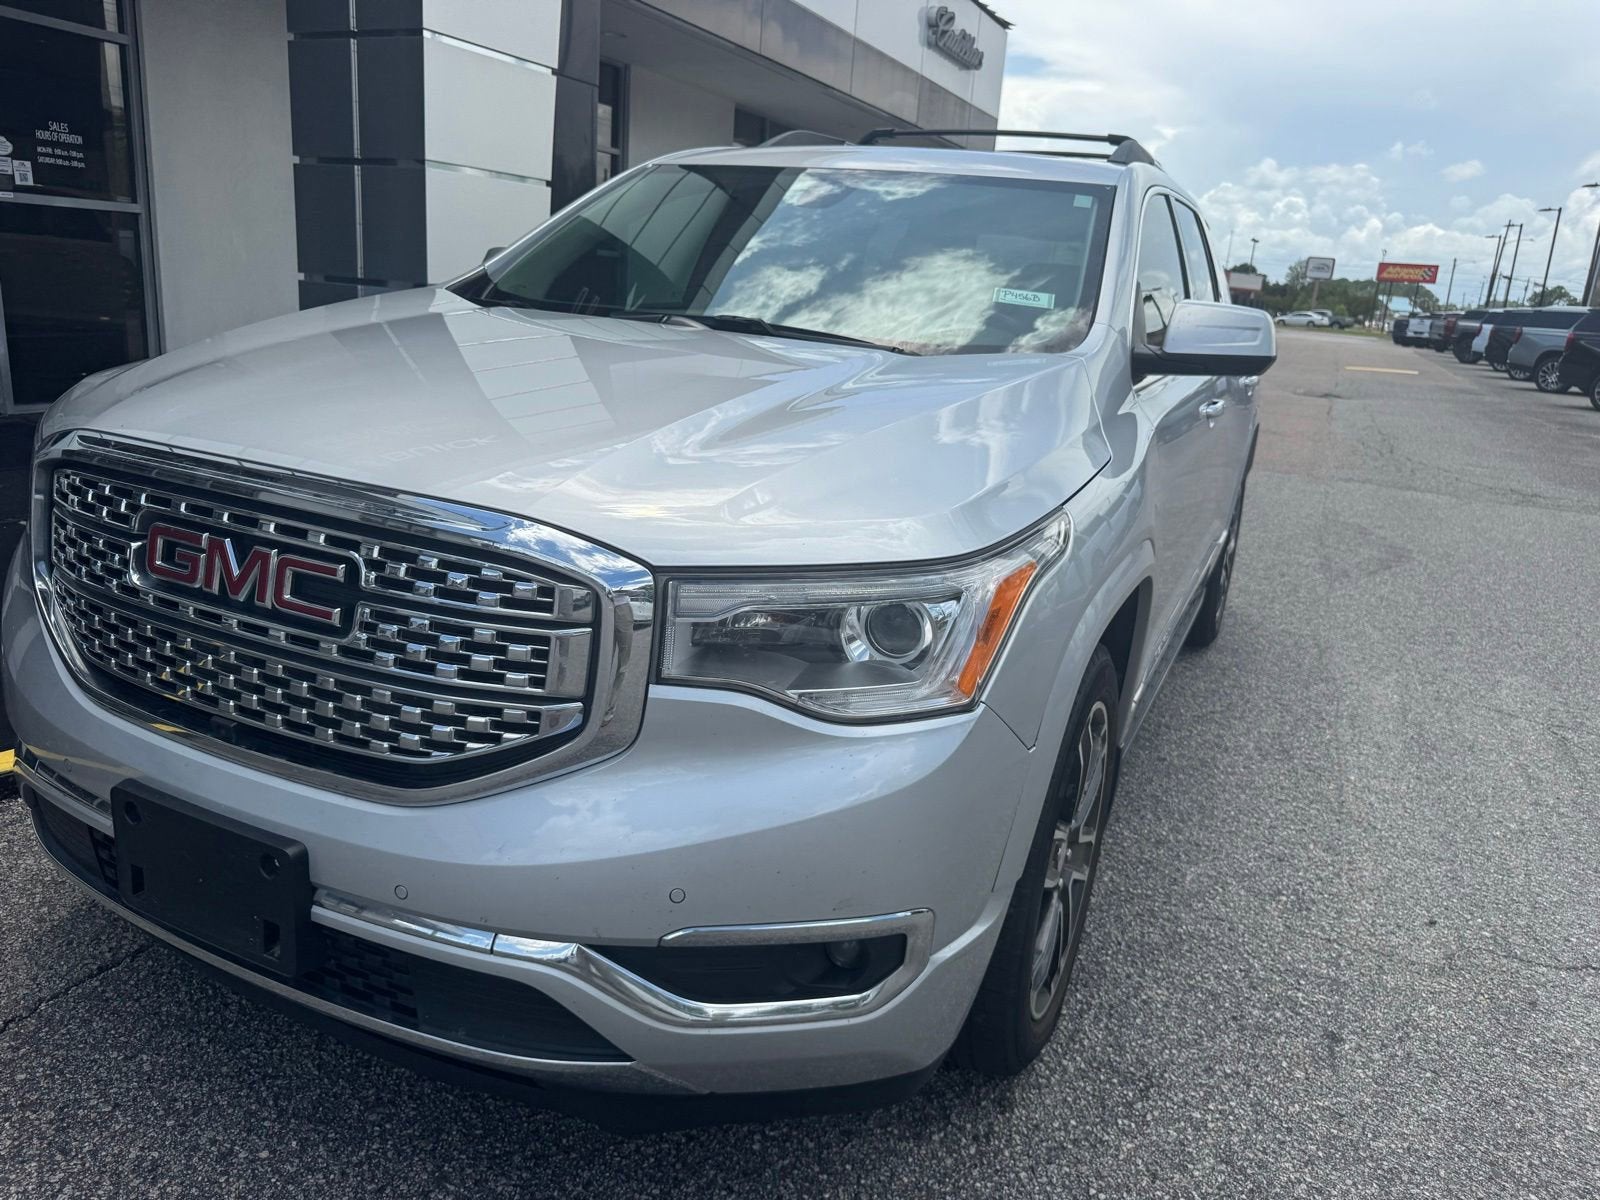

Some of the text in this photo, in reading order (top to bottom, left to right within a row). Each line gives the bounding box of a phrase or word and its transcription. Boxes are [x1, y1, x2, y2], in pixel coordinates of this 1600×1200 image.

[48, 121, 69, 132] SALES
[35, 130, 51, 140] HOURS
[59, 133, 83, 144] OPERATION
[146, 522, 346, 628] GMC
